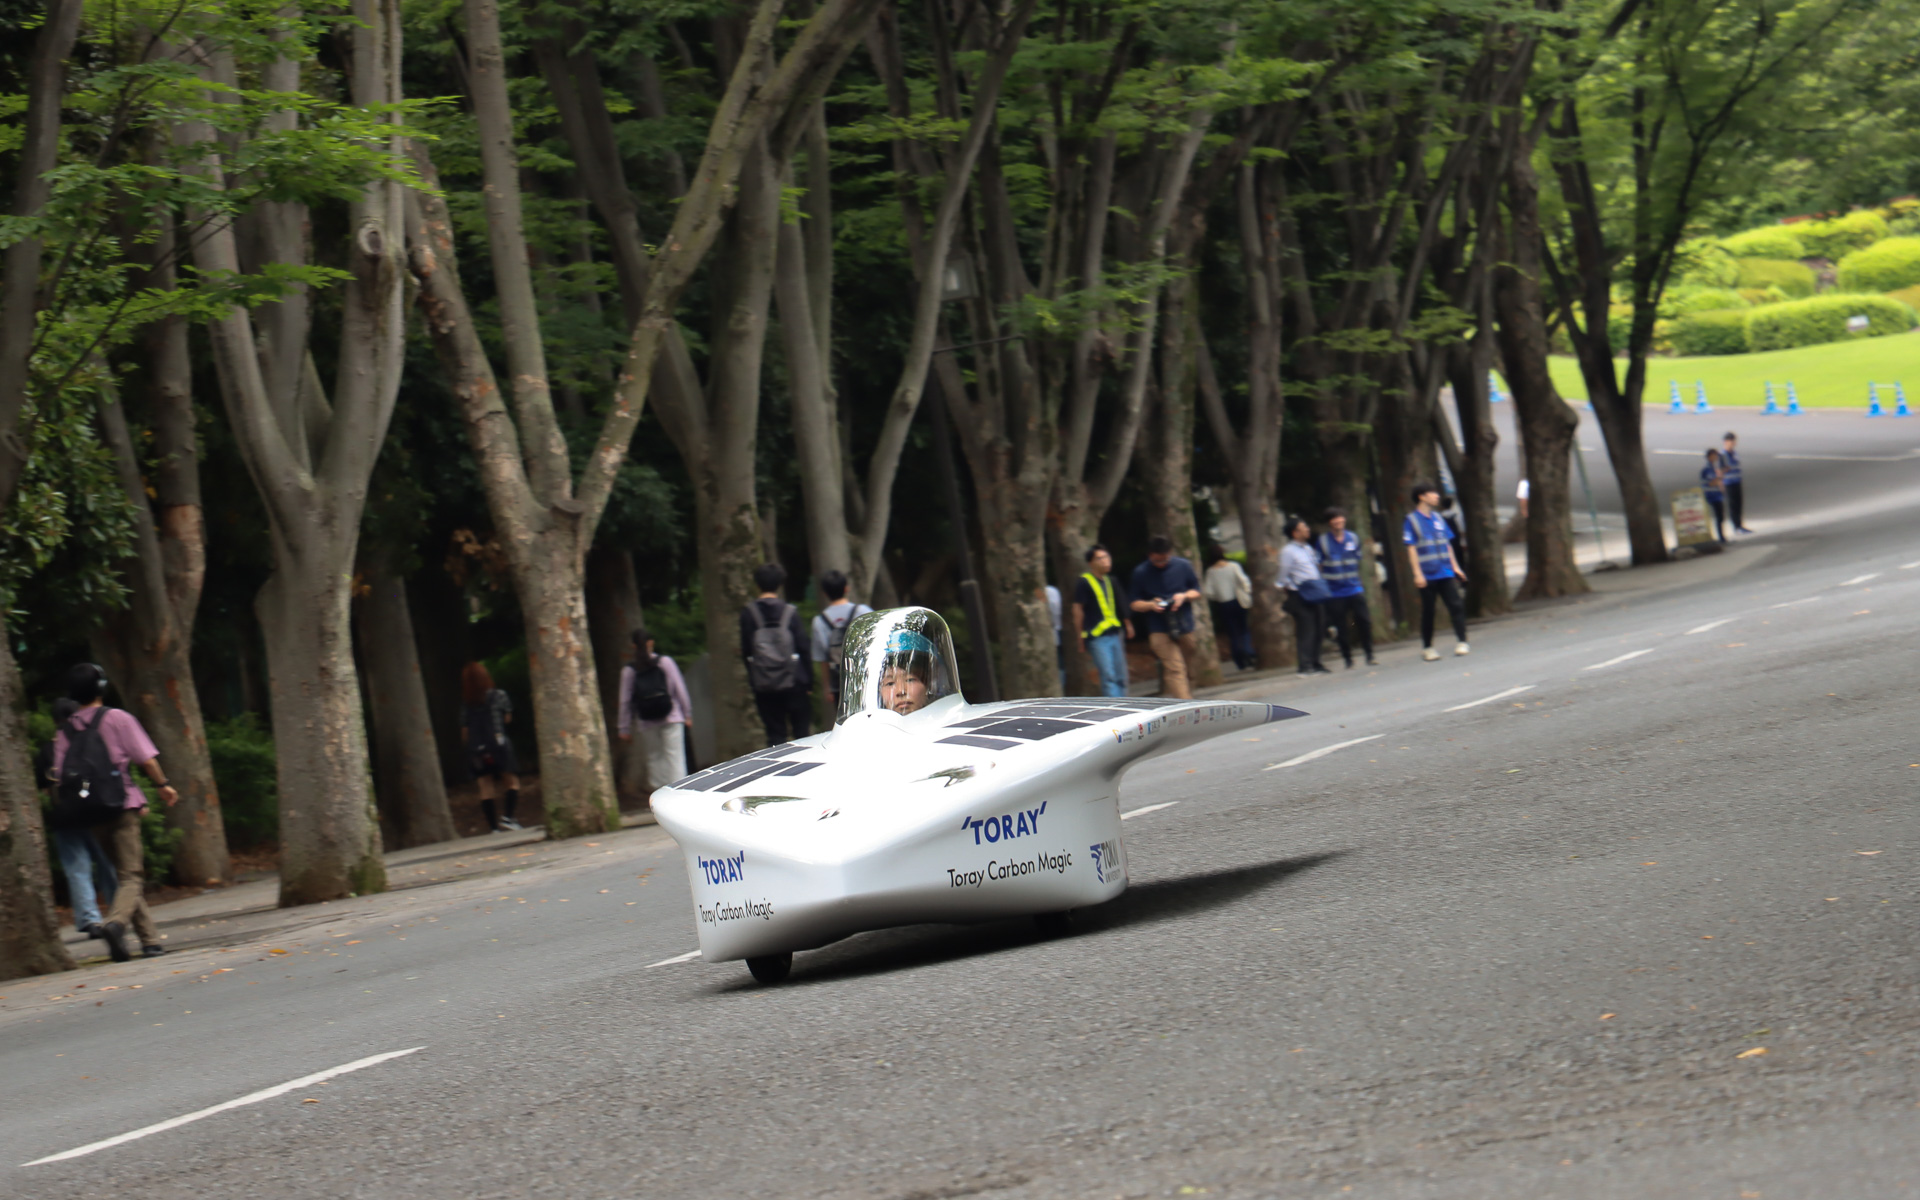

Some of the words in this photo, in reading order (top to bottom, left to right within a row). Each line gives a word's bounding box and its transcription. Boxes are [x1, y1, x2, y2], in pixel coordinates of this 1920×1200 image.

[947, 868, 985, 888] Toray
[987, 858, 1035, 880] Carbon
[1038, 848, 1072, 874] Magic
[699, 904, 717, 927] Toray
[715, 901, 745, 921] Carbon
[744, 897, 774, 920] Magic
